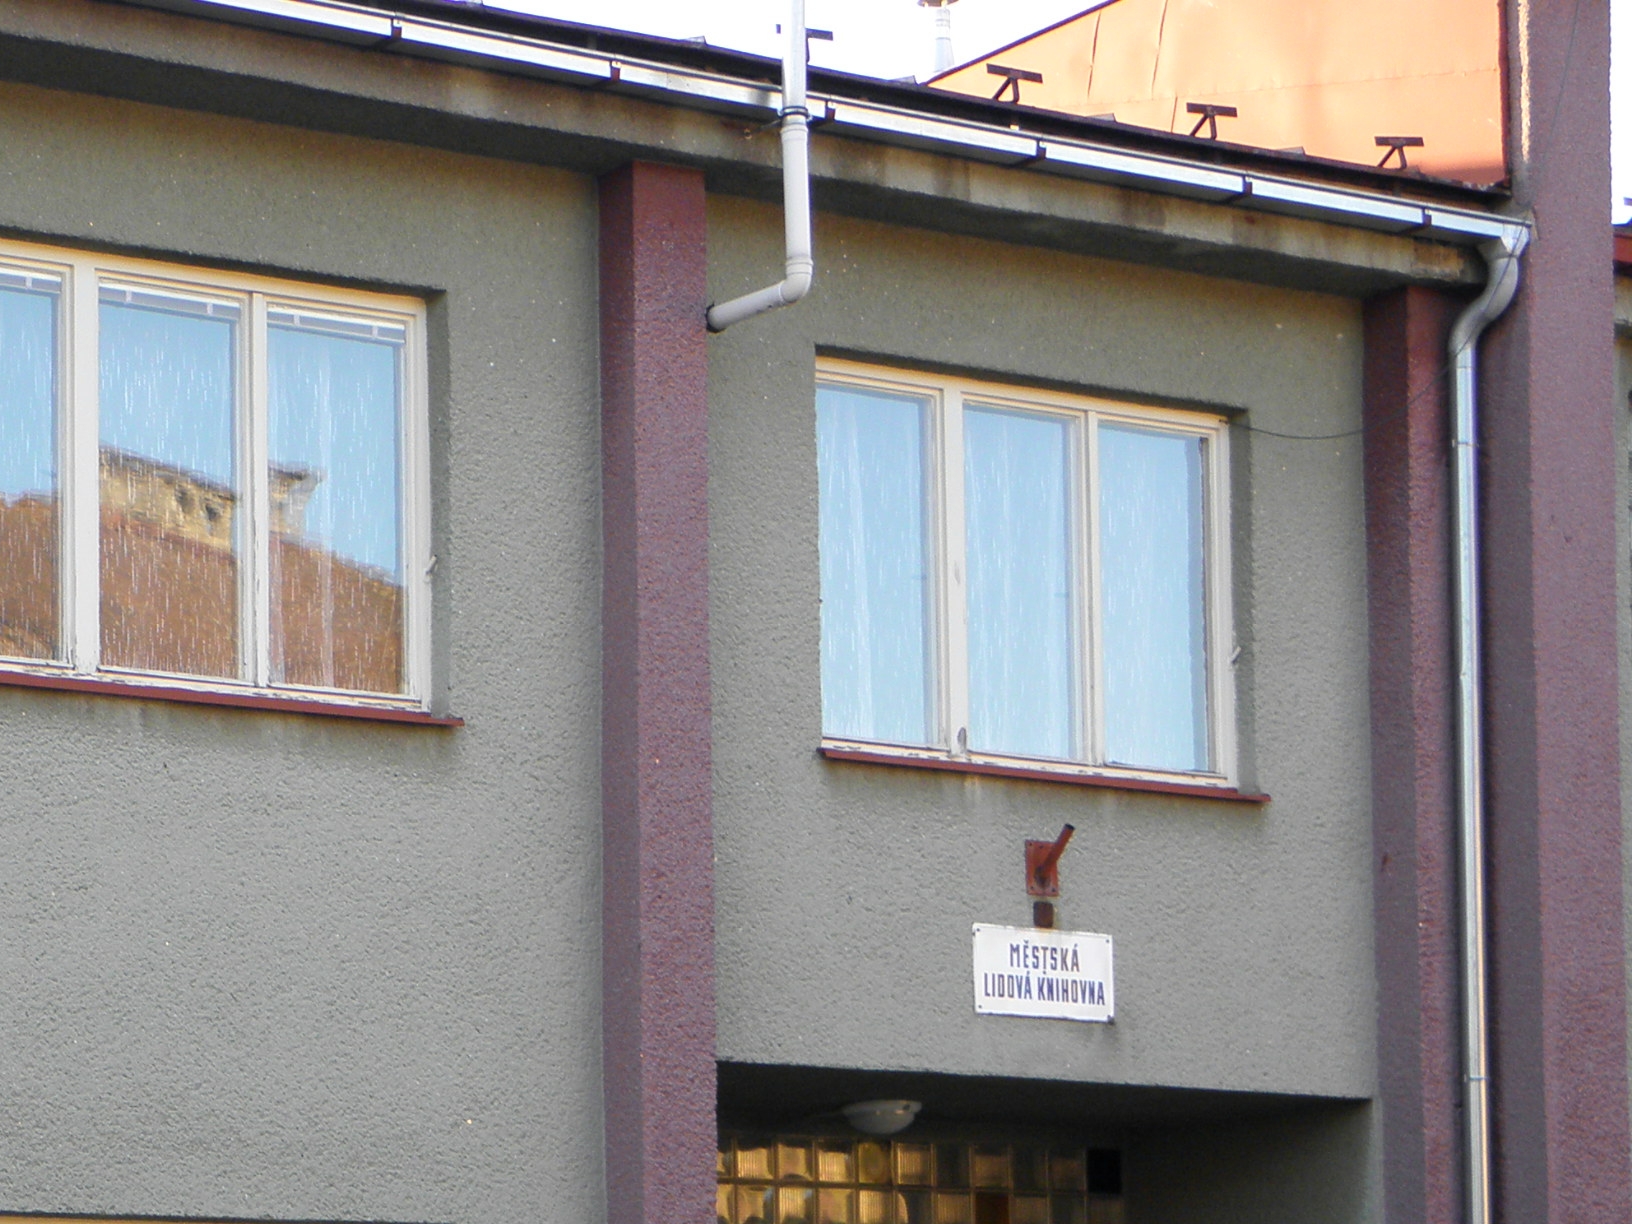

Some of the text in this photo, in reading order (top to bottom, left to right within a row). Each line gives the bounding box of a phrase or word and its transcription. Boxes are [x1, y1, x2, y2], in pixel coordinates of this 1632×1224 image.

[1009, 940, 1080, 973] MĚSTSKÁ
[983, 971, 1106, 1006] LIDOVÁ KNIHOVNA
